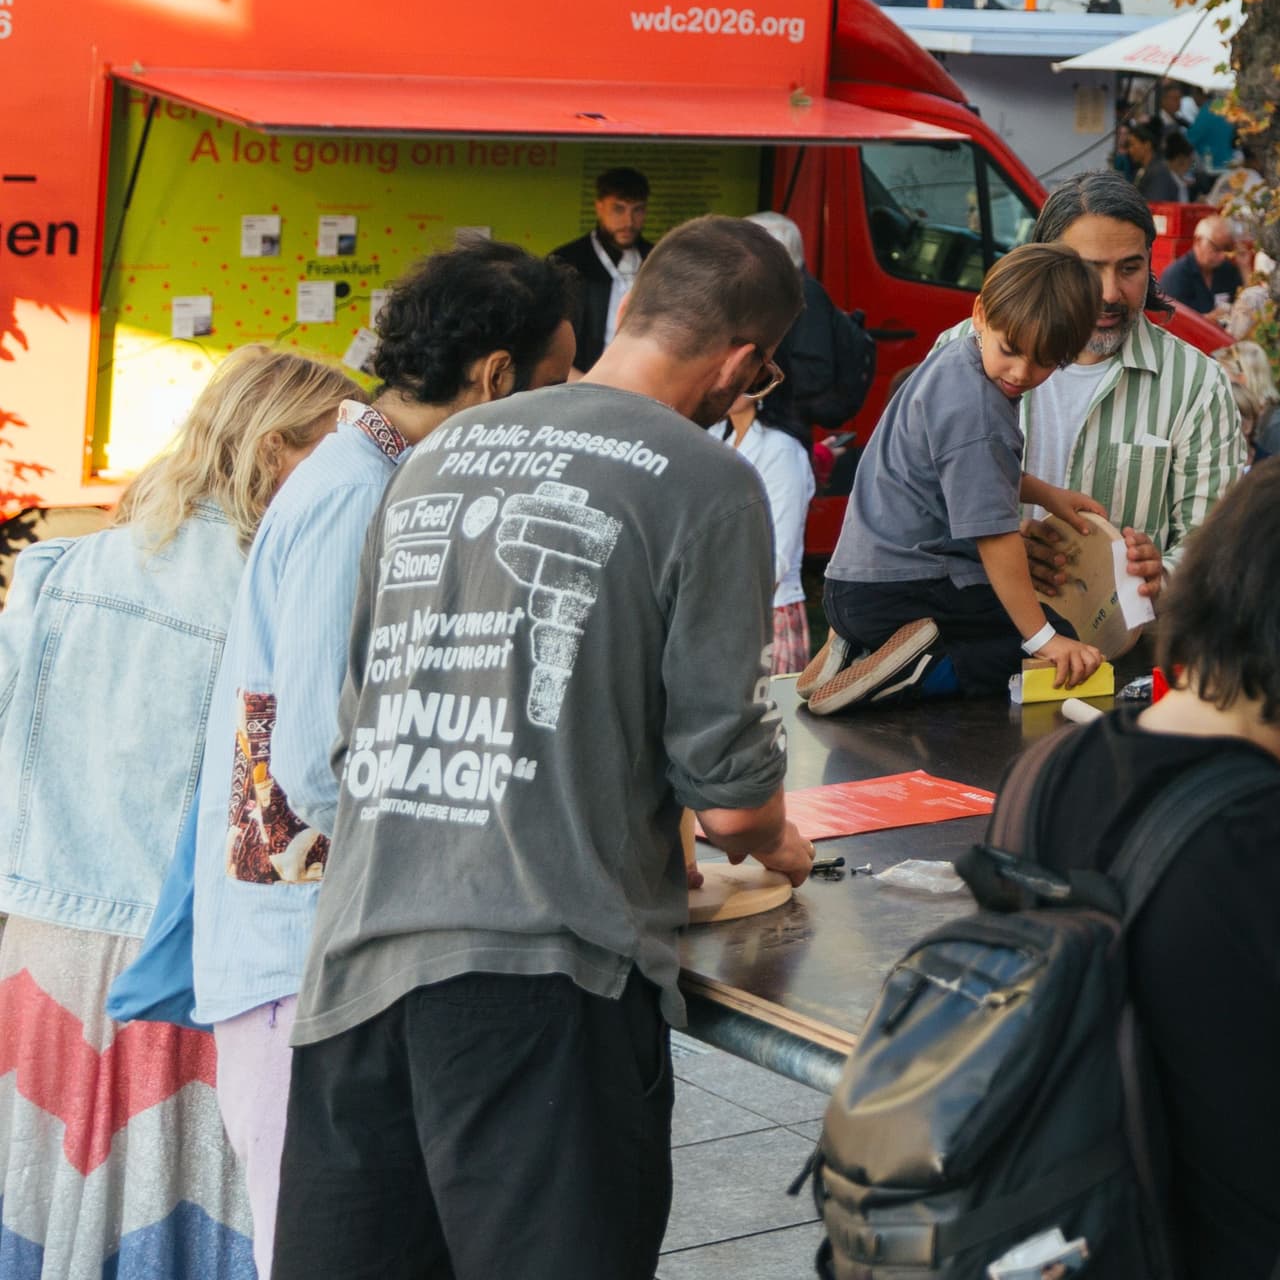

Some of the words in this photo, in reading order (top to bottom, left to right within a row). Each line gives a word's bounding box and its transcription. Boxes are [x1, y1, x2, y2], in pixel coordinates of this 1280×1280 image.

[631, 5, 805, 43] wdc2026.org
[190, 133, 219, 164] A
[233, 134, 281, 165] lot
[294, 135, 398, 174] going
[411, 141, 455, 166] on
[469, 141, 558, 168] here!
[7, 220, 79, 256] en
[306, 261, 381, 276] Frankfurt
[438, 451, 573, 478] PRACTICE
[462, 423, 529, 448] Public
[530, 426, 669, 476] Possession
[409, 500, 453, 529] Feet
[392, 550, 440, 579] Stone
